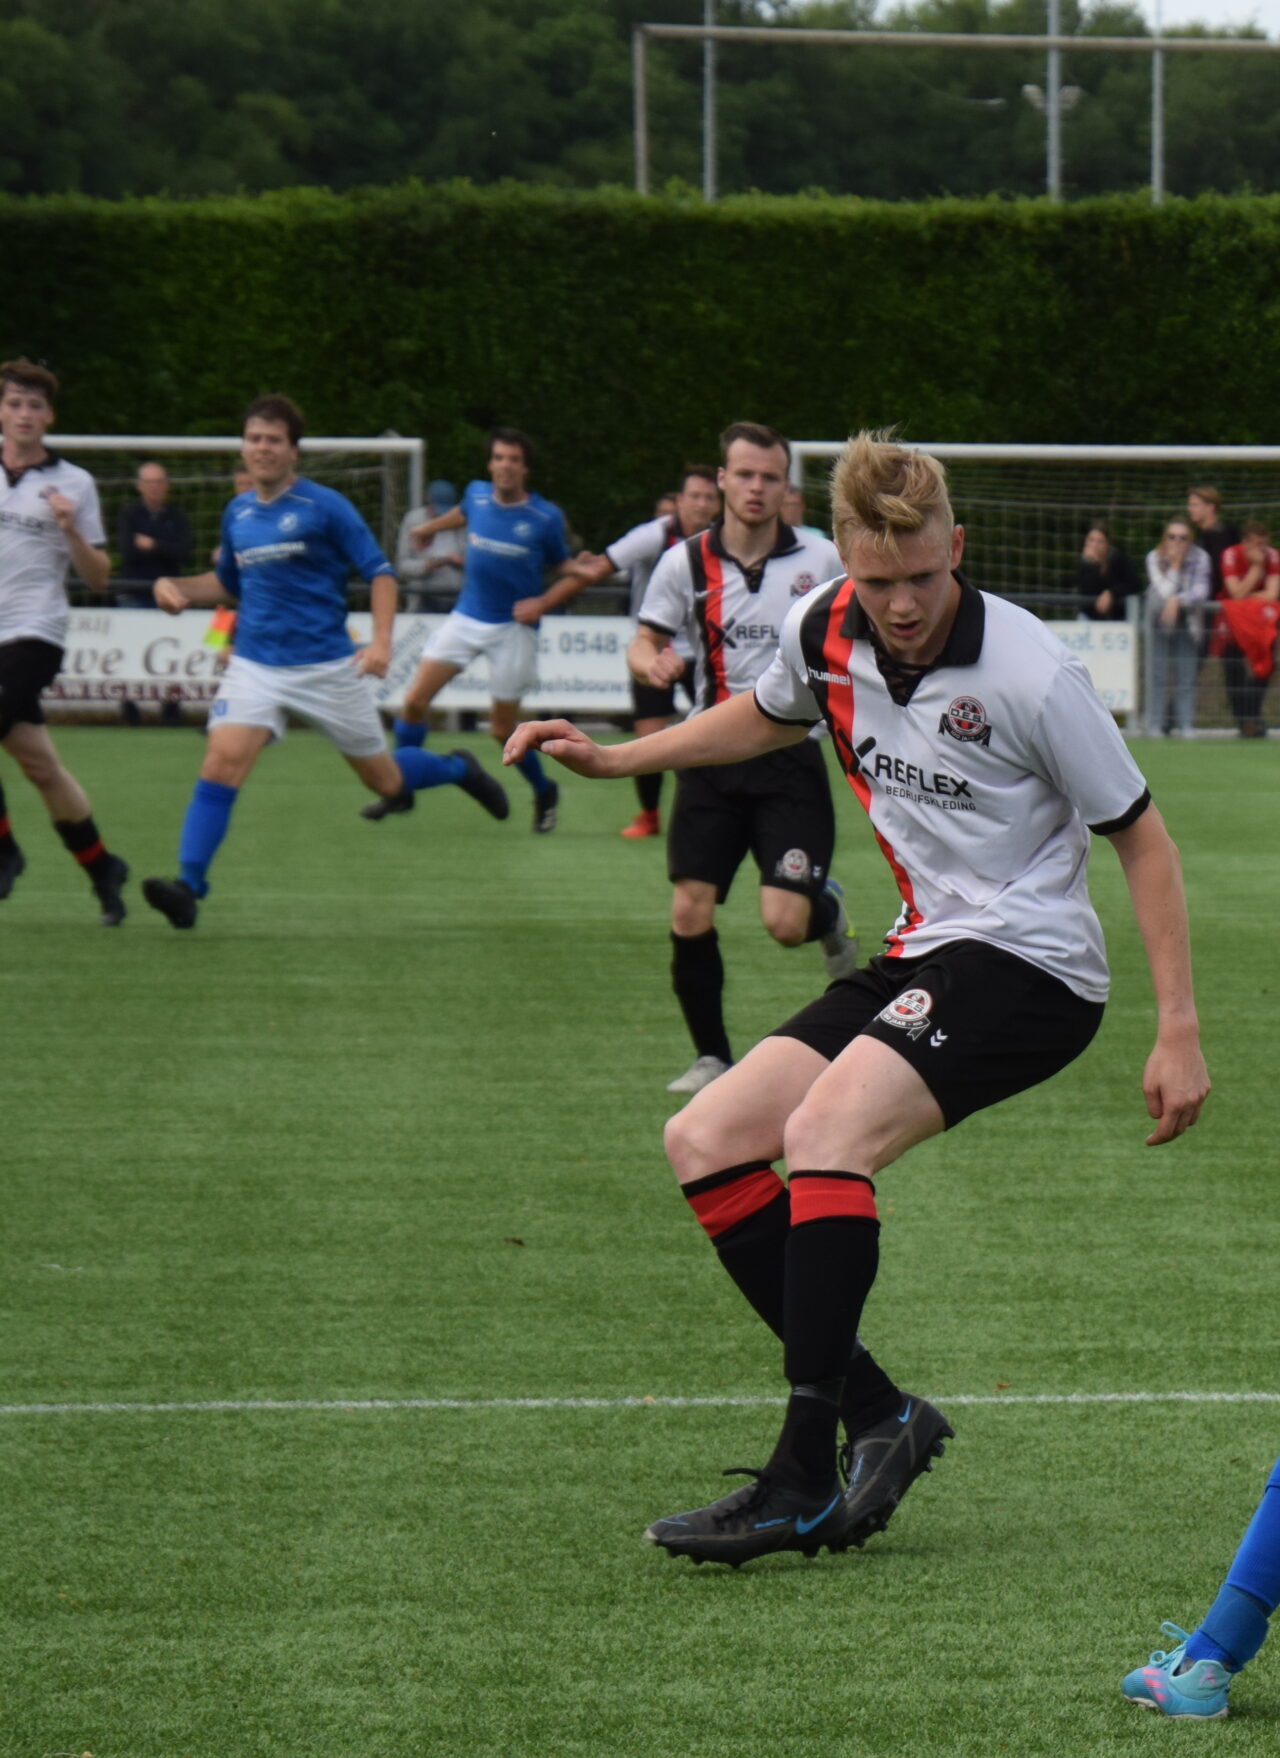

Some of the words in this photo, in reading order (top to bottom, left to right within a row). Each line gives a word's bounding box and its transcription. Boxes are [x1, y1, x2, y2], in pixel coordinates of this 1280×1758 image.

[736, 625, 780, 639] REFL
[807, 667, 851, 686] hummel
[875, 753, 973, 799] REFLEX
